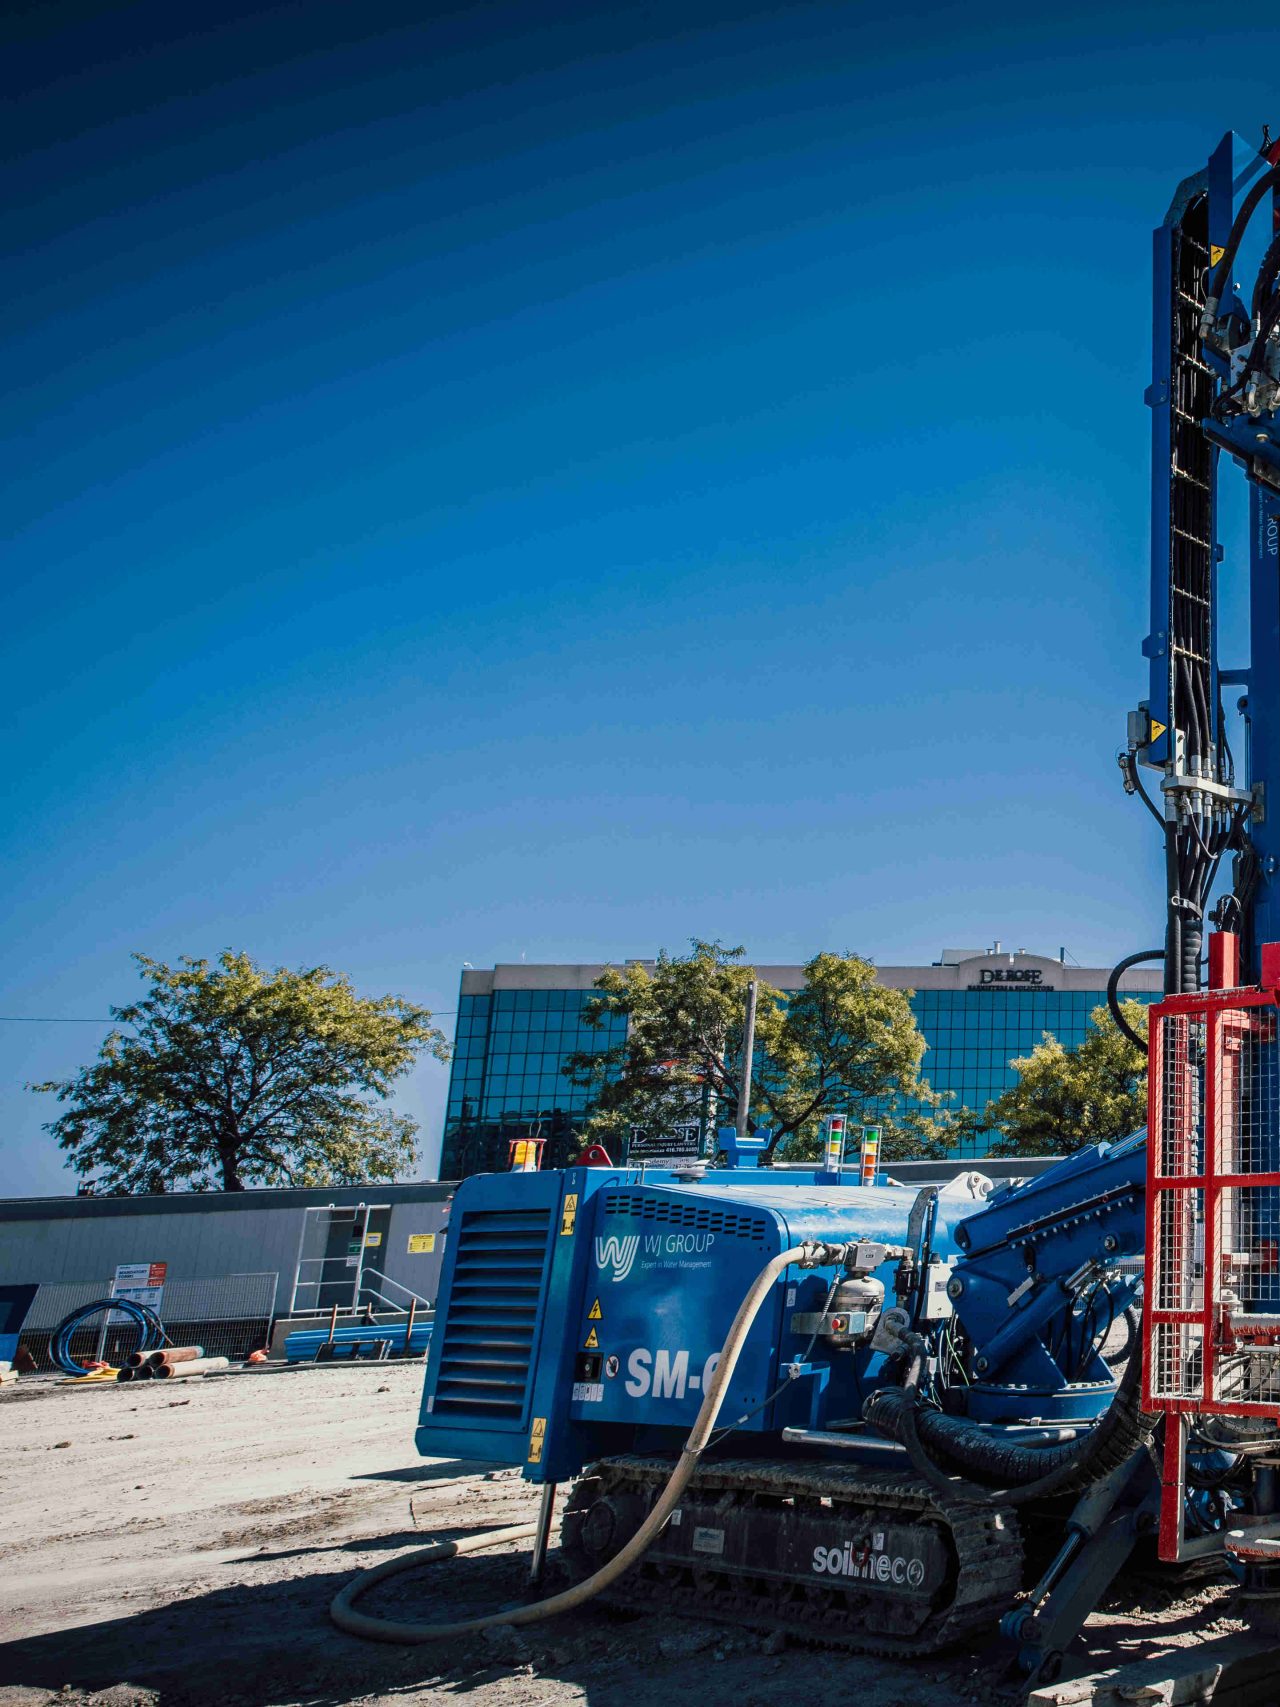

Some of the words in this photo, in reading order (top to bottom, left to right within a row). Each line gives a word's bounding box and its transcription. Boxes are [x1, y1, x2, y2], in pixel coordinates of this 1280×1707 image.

[1267, 513, 1278, 555] ROUP
[644, 1234, 662, 1257] WJ
[665, 1233, 715, 1253] GROUP
[640, 1261, 657, 1269] Expert
[663, 1260, 678, 1269] Water
[678, 1260, 712, 1270] Management
